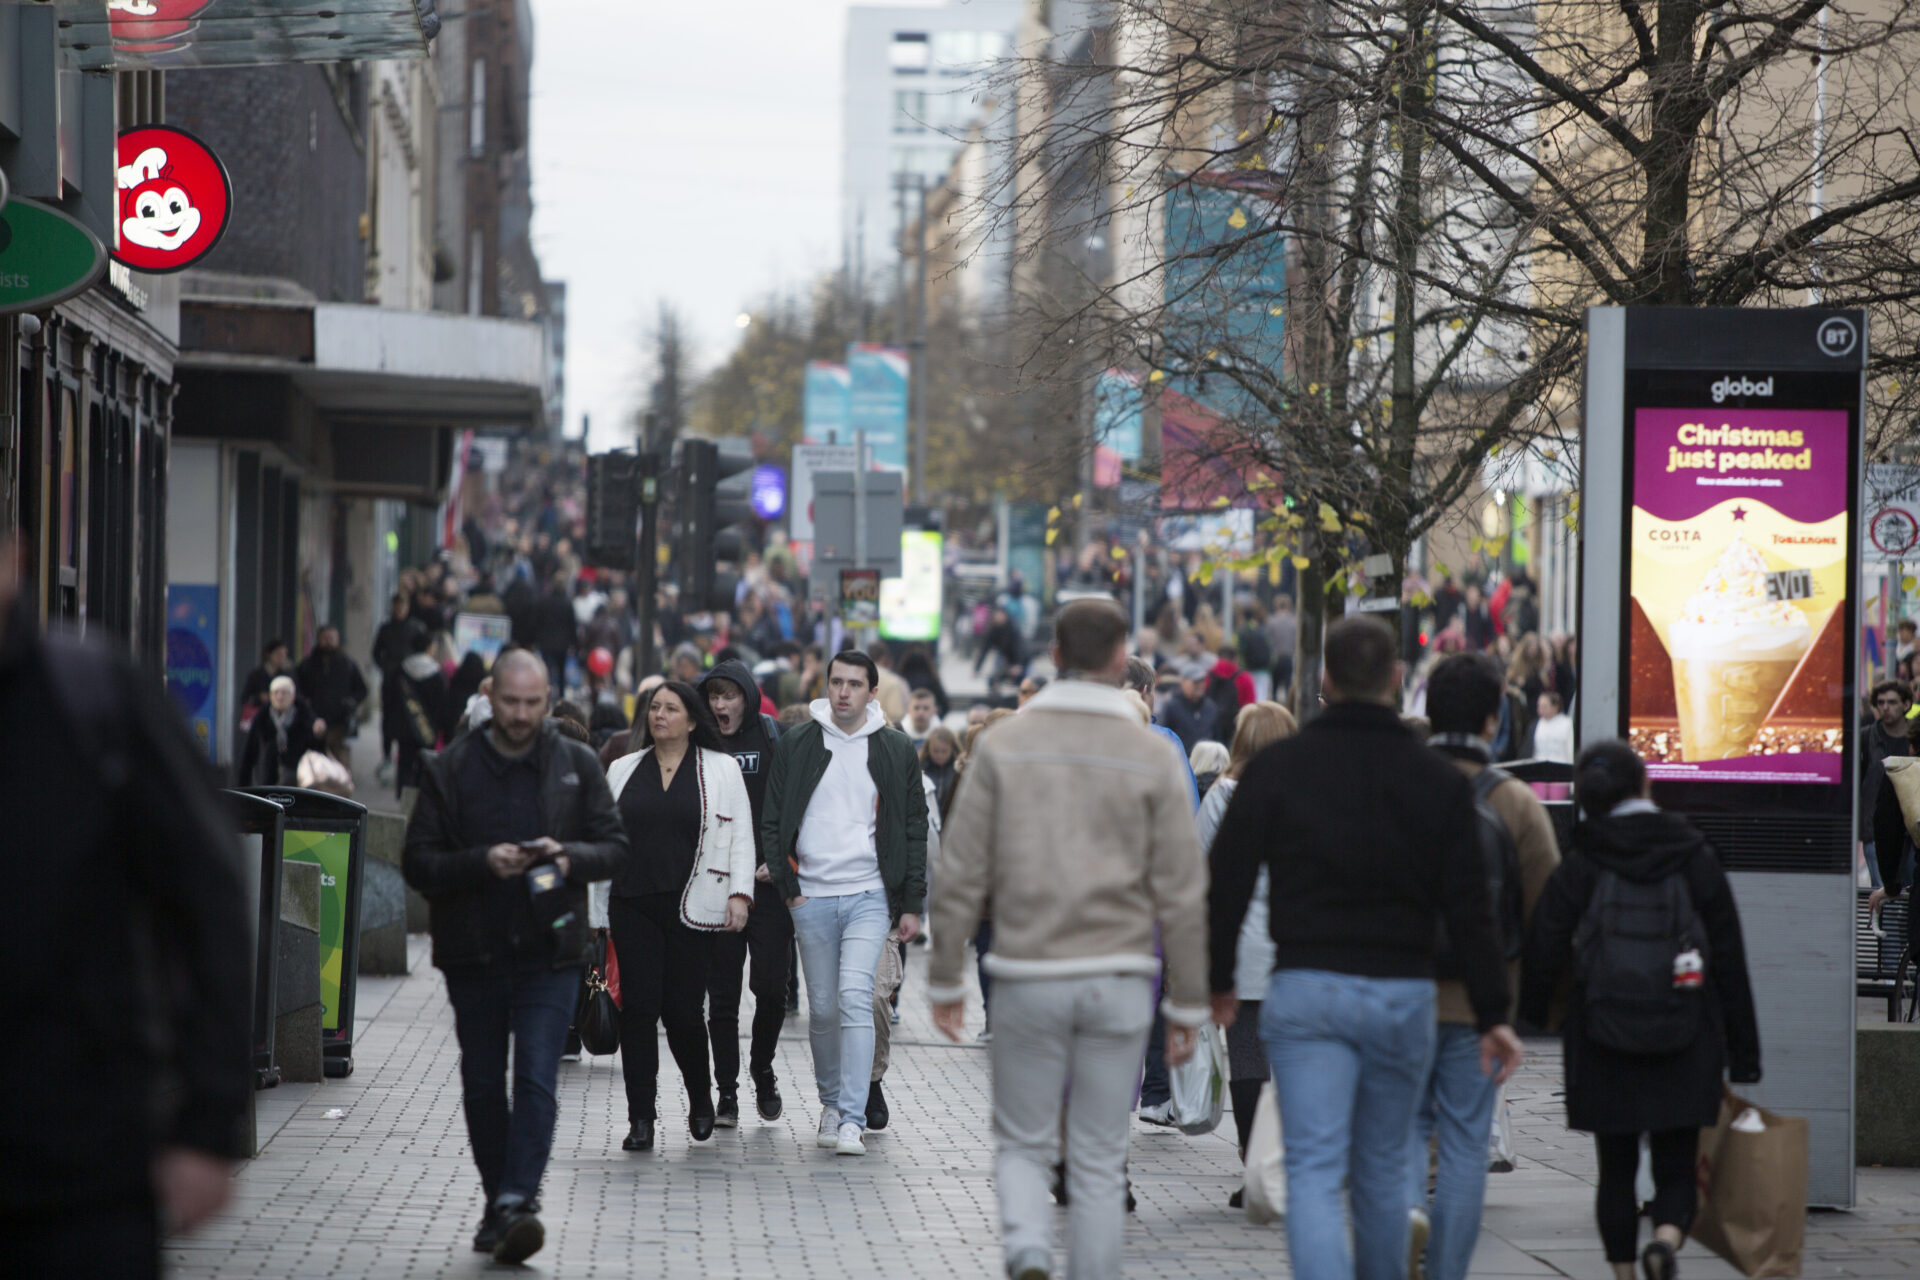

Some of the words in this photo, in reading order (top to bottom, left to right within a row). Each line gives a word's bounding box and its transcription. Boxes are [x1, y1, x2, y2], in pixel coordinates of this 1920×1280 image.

[1826, 329, 1849, 345] BT
[1711, 376, 1774, 403] global
[1677, 423, 1804, 446] Christmas
[1666, 446, 1716, 473] just
[1718, 448, 1812, 473] peaked
[1649, 529, 1702, 544] COSTA
